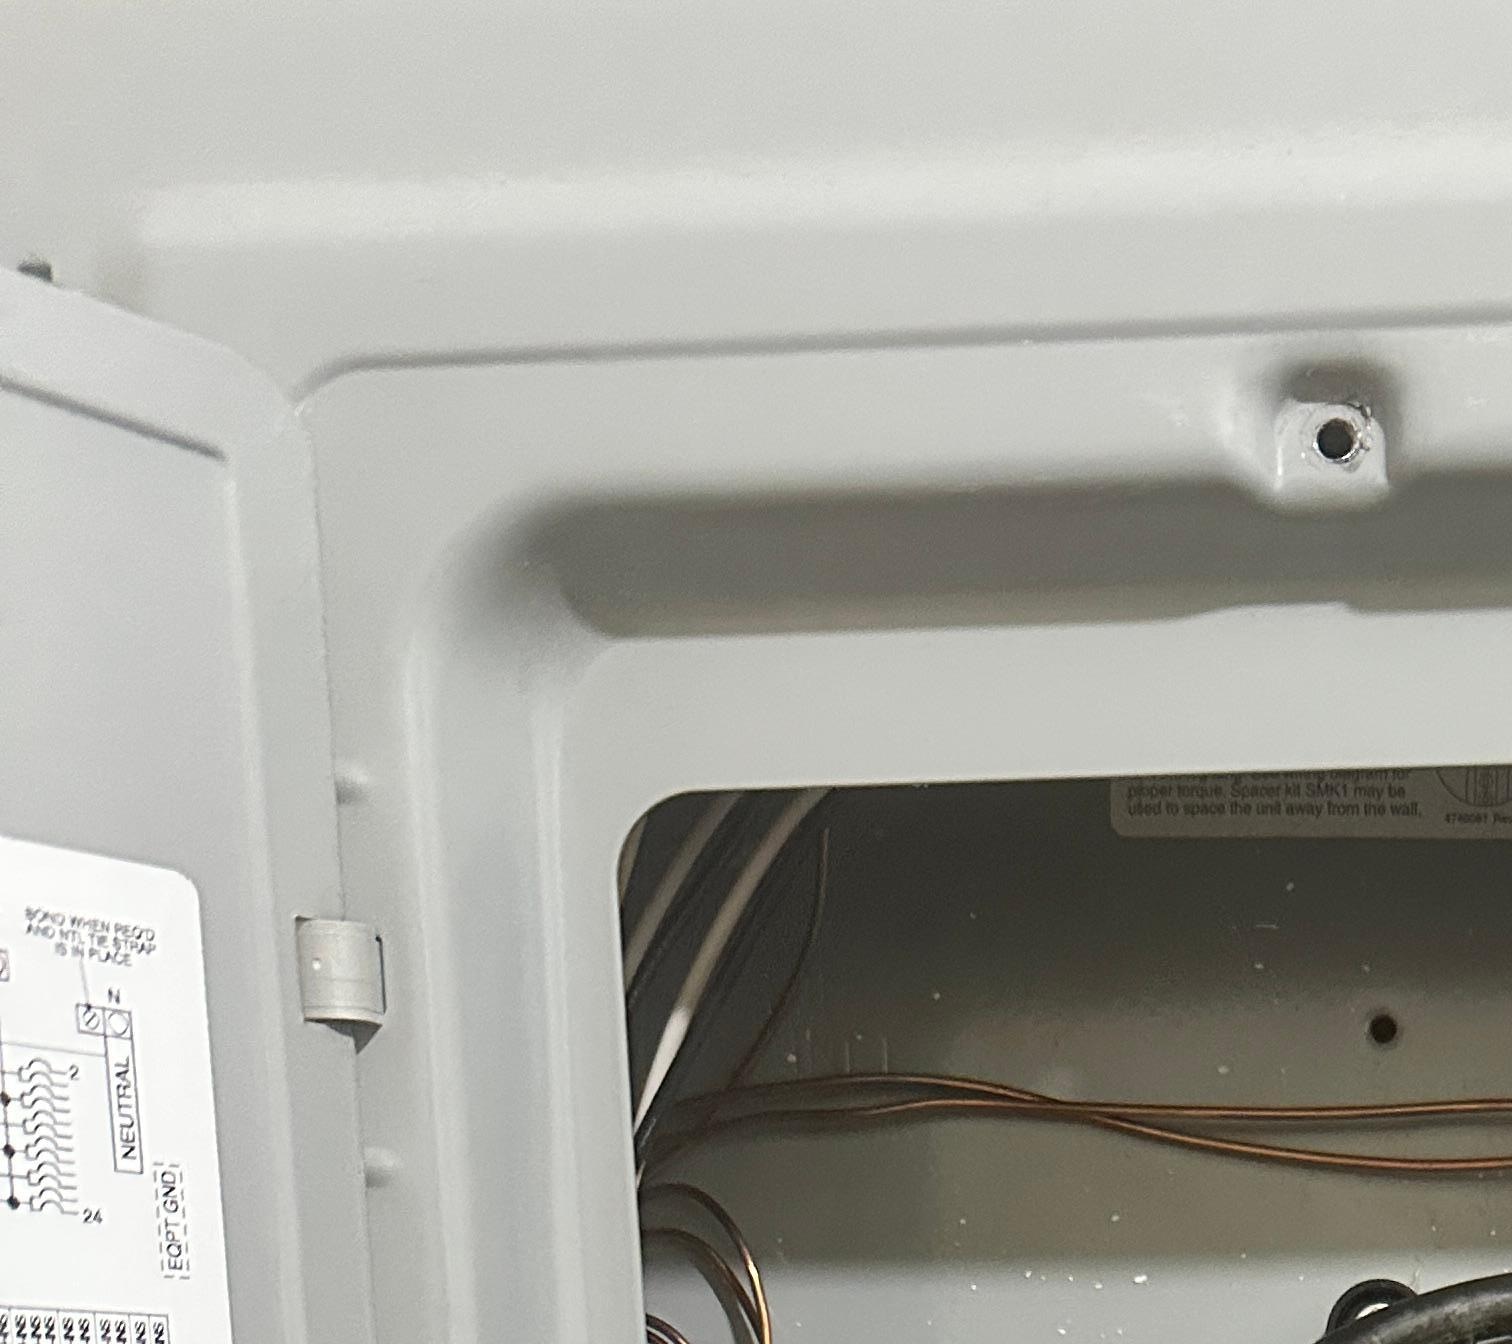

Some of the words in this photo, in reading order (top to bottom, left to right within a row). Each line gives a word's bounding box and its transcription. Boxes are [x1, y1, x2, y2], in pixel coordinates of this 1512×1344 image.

[107, 987, 121, 1005] N
[67, 1064, 80, 1081] 2
[114, 1055, 137, 1160] NEUTRAL
[160, 1170, 179, 1213] GND
[82, 1208, 103, 1225] 24
[164, 1217, 183, 1270] EQPT
